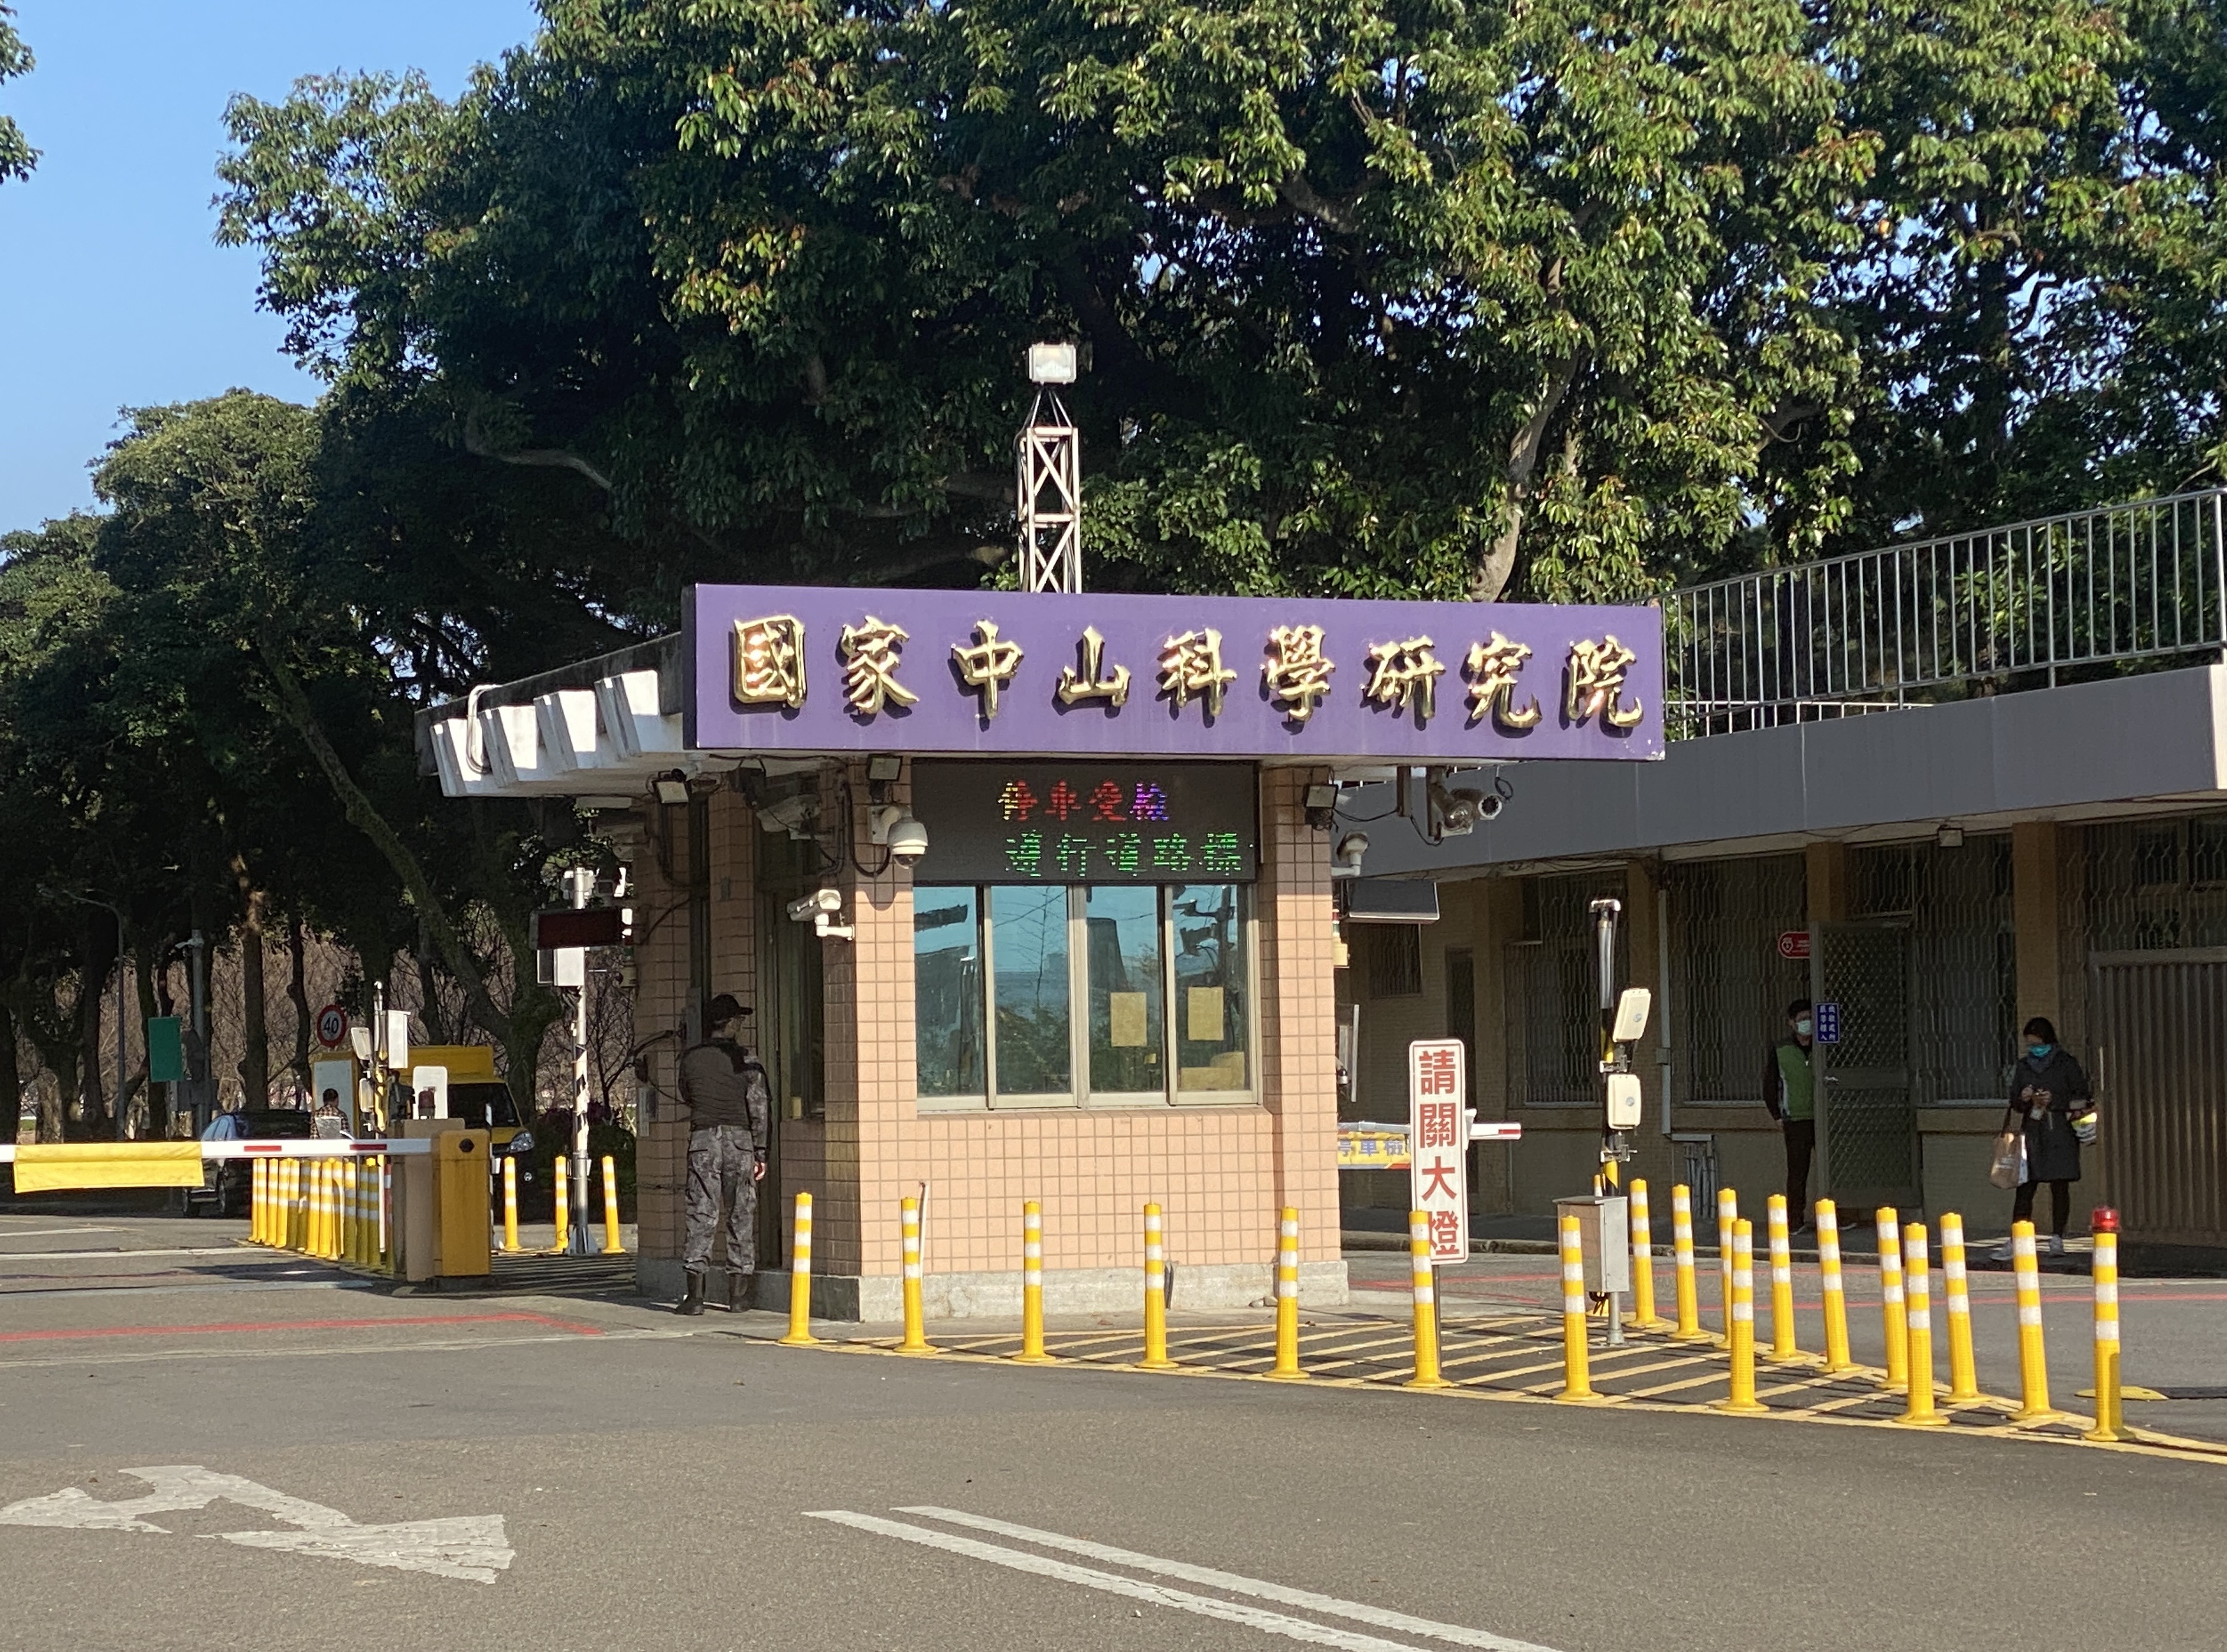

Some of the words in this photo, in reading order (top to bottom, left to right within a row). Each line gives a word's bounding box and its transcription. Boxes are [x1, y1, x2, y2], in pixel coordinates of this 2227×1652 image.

[731, 613, 1644, 730] 國家中山科學研究院
[324, 1016, 339, 1034] 40
[1419, 1049, 1459, 1256] 請關大燈
